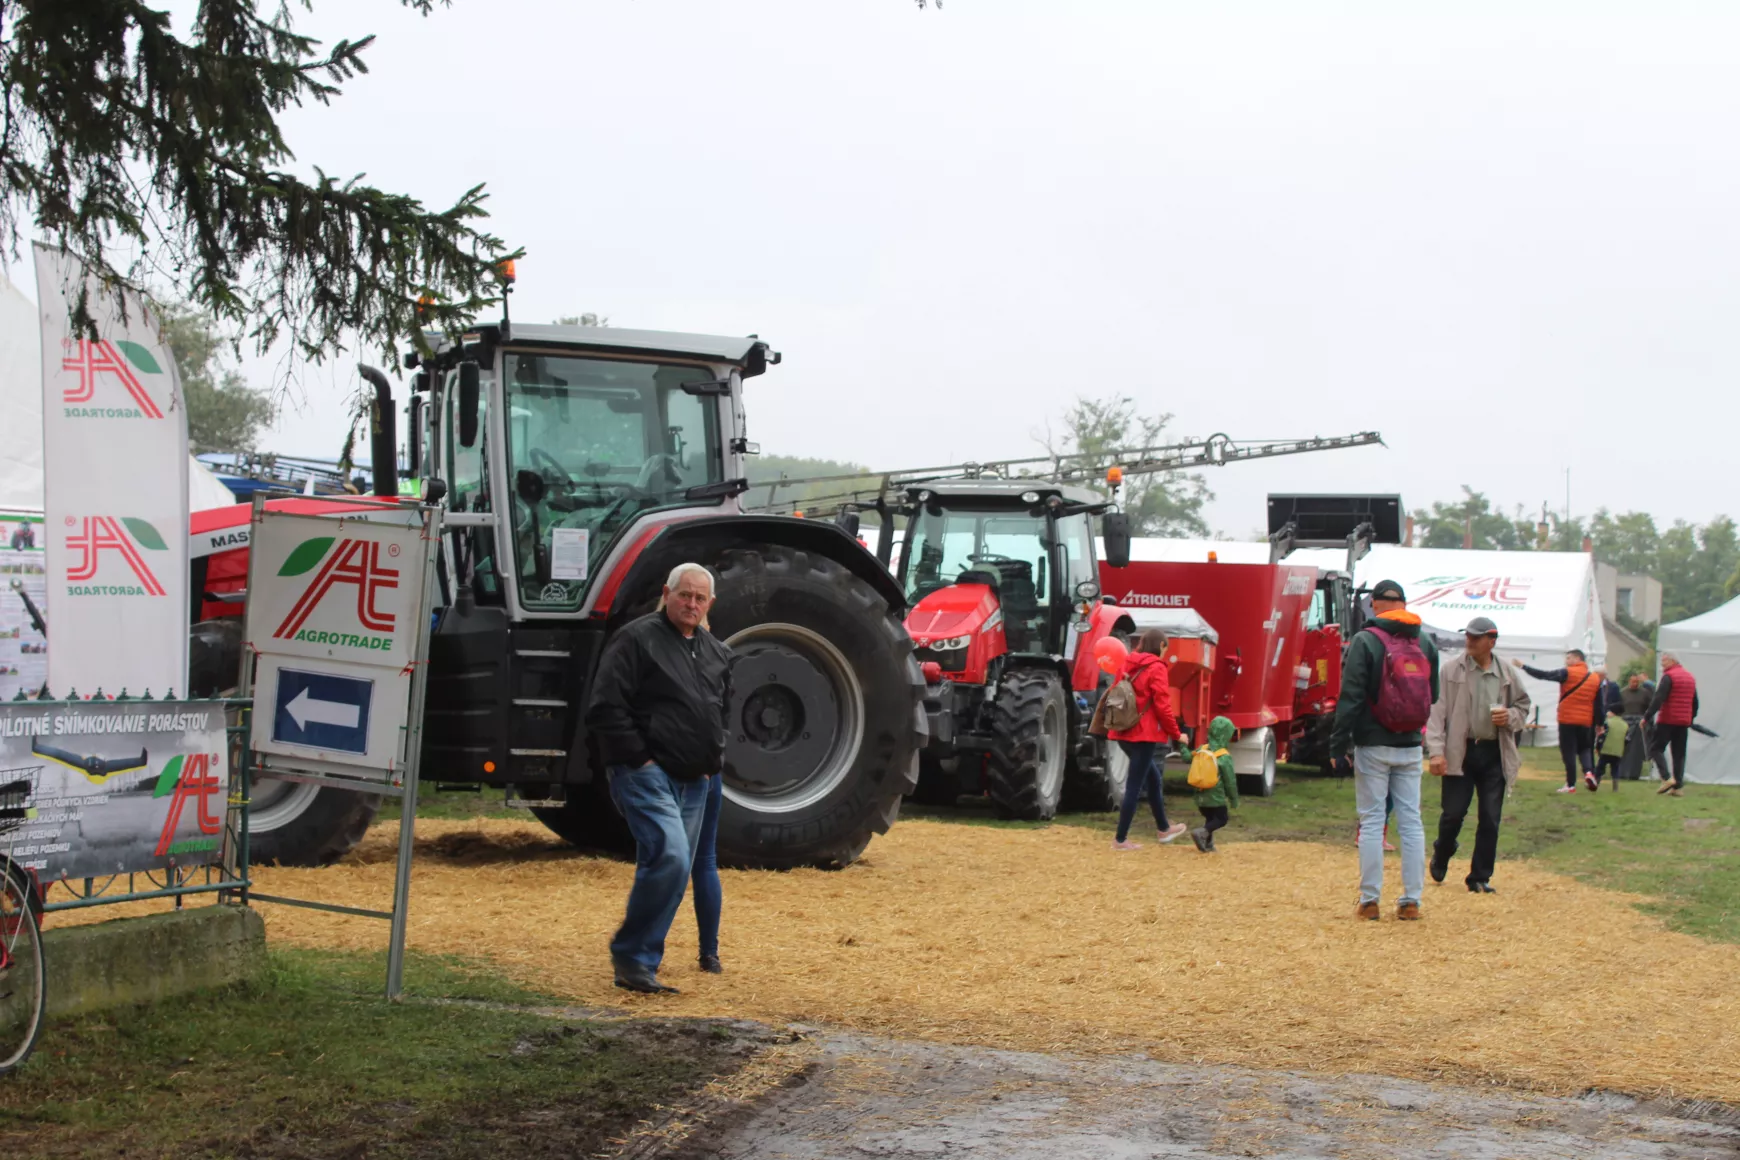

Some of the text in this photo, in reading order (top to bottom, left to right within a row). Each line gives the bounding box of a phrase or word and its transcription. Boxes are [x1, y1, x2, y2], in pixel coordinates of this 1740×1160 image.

[210, 530, 252, 549] MAS
[1131, 594, 1191, 607] TRIOLIET
[294, 628, 394, 651] AGROTRADE
[53, 711, 147, 736] SNÍMKOVANIE
[147, 711, 209, 733] PORASTOV
